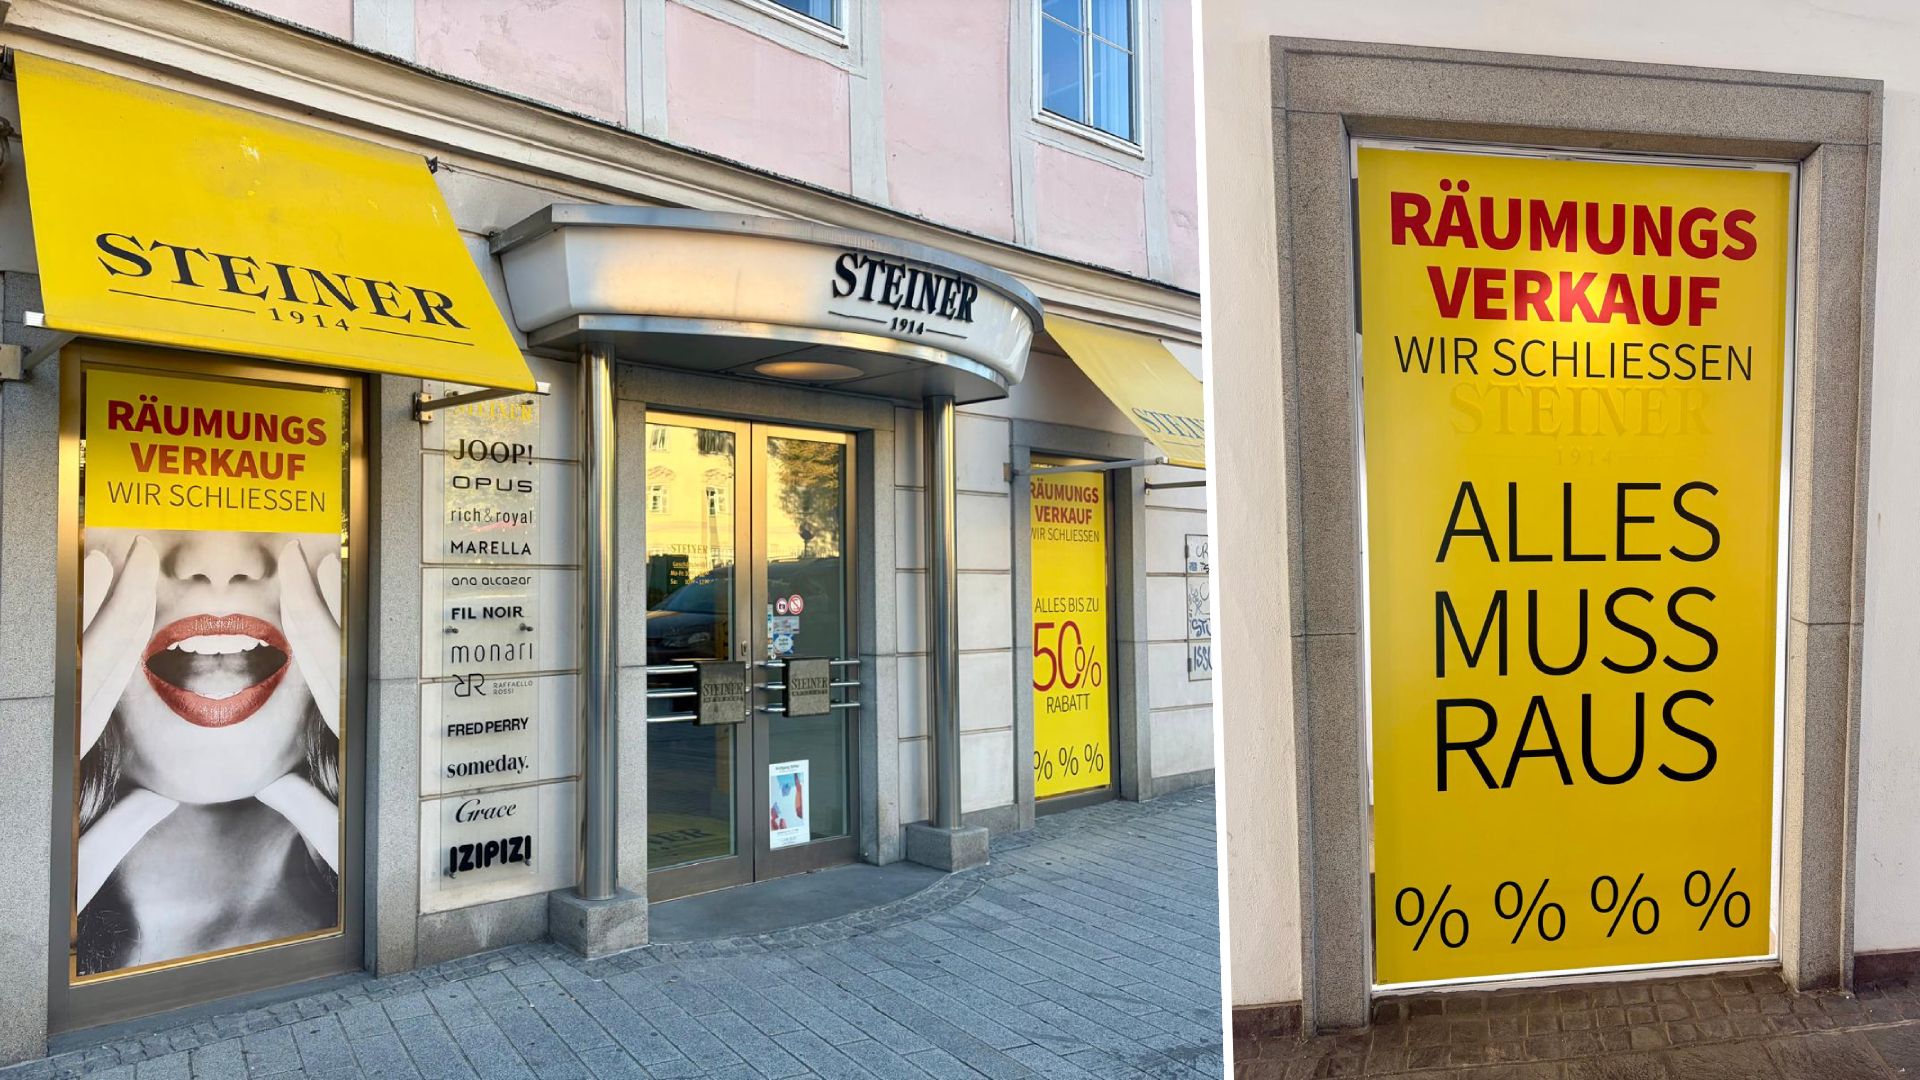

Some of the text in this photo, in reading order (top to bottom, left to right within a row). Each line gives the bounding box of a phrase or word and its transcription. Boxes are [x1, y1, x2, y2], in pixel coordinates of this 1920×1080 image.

[1391, 178, 1757, 261] RÄUMUNGS
[96, 232, 471, 330] STEINER
[832, 253, 978, 323] STEINER
[1427, 265, 1720, 326] VERKAUF
[270, 307, 349, 332] 1914
[890, 317, 924, 335] 1914
[1394, 335, 1752, 381] WIR SCHLIESSEN
[108, 394, 327, 446] RÄUMUNGS
[1449, 381, 1713, 437] STEINER
[130, 442, 306, 481] VERKAUF
[453, 439, 533, 465] JOOP!
[107, 481, 325, 512] WIR SCHLIESSEN
[453, 476, 532, 493] OPUS
[1030, 478, 1099, 503] RÄUMUNGS
[1035, 505, 1092, 524] VERKAUF
[1435, 481, 1720, 562] ALLES
[451, 540, 532, 555] MARELLA
[1048, 528, 1099, 542] SCHLIESSEN
[451, 577, 532, 586] ana alcazar
[452, 606, 524, 620] FIL NOIR
[1034, 597, 1099, 613] ALLES BIS ZU
[1435, 586, 1719, 678] MUSS
[451, 643, 532, 663] monari
[703, 682, 743, 697] STEINER
[791, 677, 828, 690] STEINER
[1047, 693, 1090, 714] RABATT
[447, 717, 529, 737] FRED PERRY
[1436, 690, 1718, 792] RAUS
[447, 754, 529, 778] someday.
[455, 799, 517, 823] Grace
[450, 835, 532, 873] IZIPIZI
